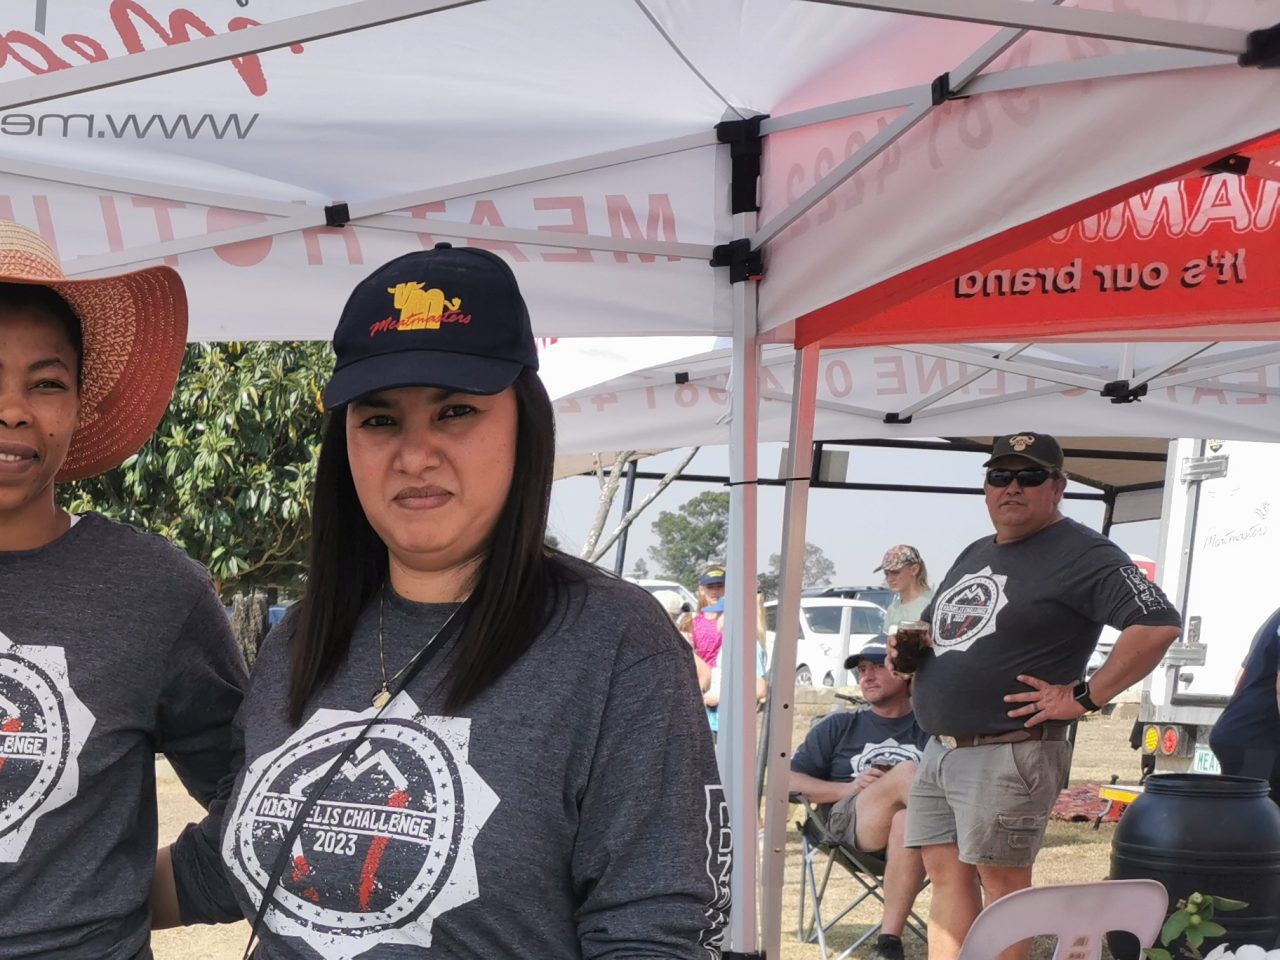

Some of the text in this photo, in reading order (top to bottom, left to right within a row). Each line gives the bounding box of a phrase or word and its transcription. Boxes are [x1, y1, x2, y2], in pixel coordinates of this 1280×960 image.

[259, 797, 432, 838] MICHLIS CHALLENGE
[313, 830, 359, 856] 2023
